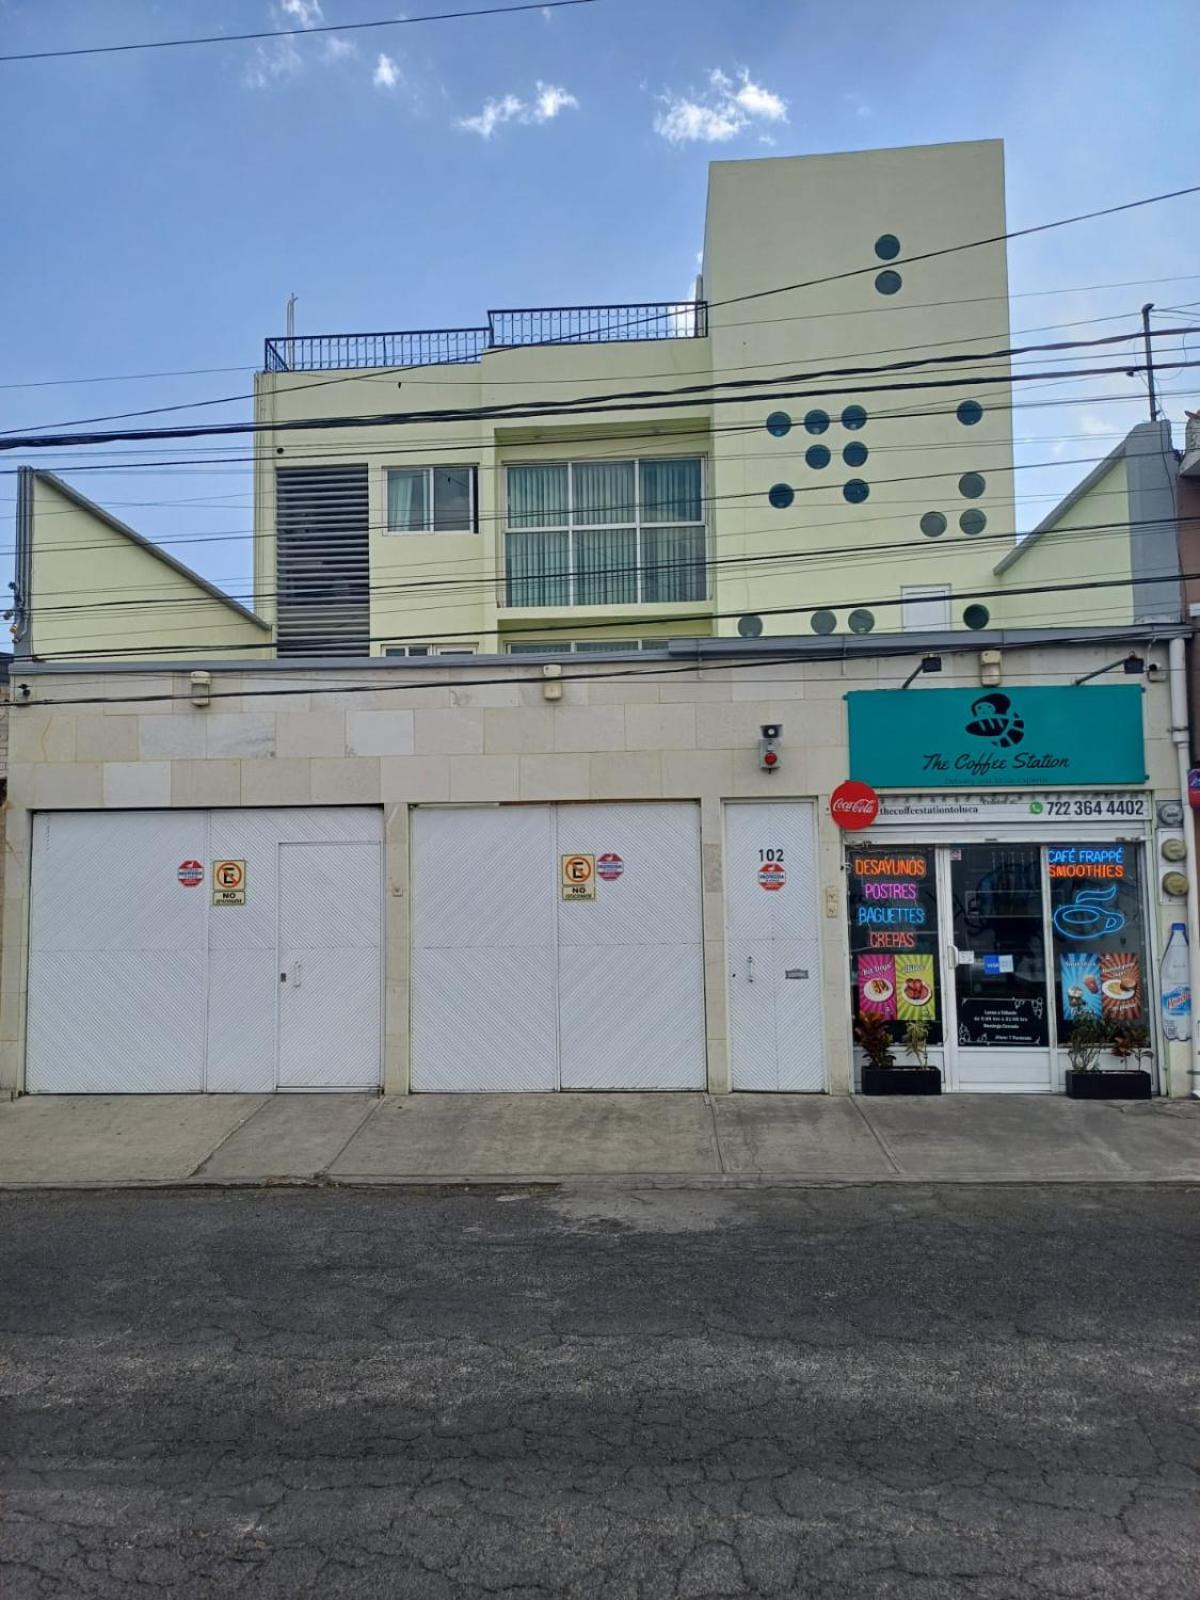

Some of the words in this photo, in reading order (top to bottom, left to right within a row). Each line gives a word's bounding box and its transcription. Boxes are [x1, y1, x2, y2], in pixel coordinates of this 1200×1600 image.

[922, 753, 949, 770] The
[954, 752, 1007, 776] Coffee
[1012, 752, 1070, 769] Station
[1047, 801, 1071, 816] 722
[1074, 800, 1102, 816] 364
[1106, 799, 1144, 816] 4402
[758, 849, 784, 862] 102
[1048, 847, 1077, 863] CAFÉ
[1079, 847, 1124, 864] FRAPPÉ
[855, 858, 926, 876] DESAYUNOS
[1048, 864, 1125, 878] SMOOTHIES
[864, 883, 917, 900] POSTRES
[858, 906, 925, 924] BAGUETTES
[869, 931, 915, 948] CREPAS
